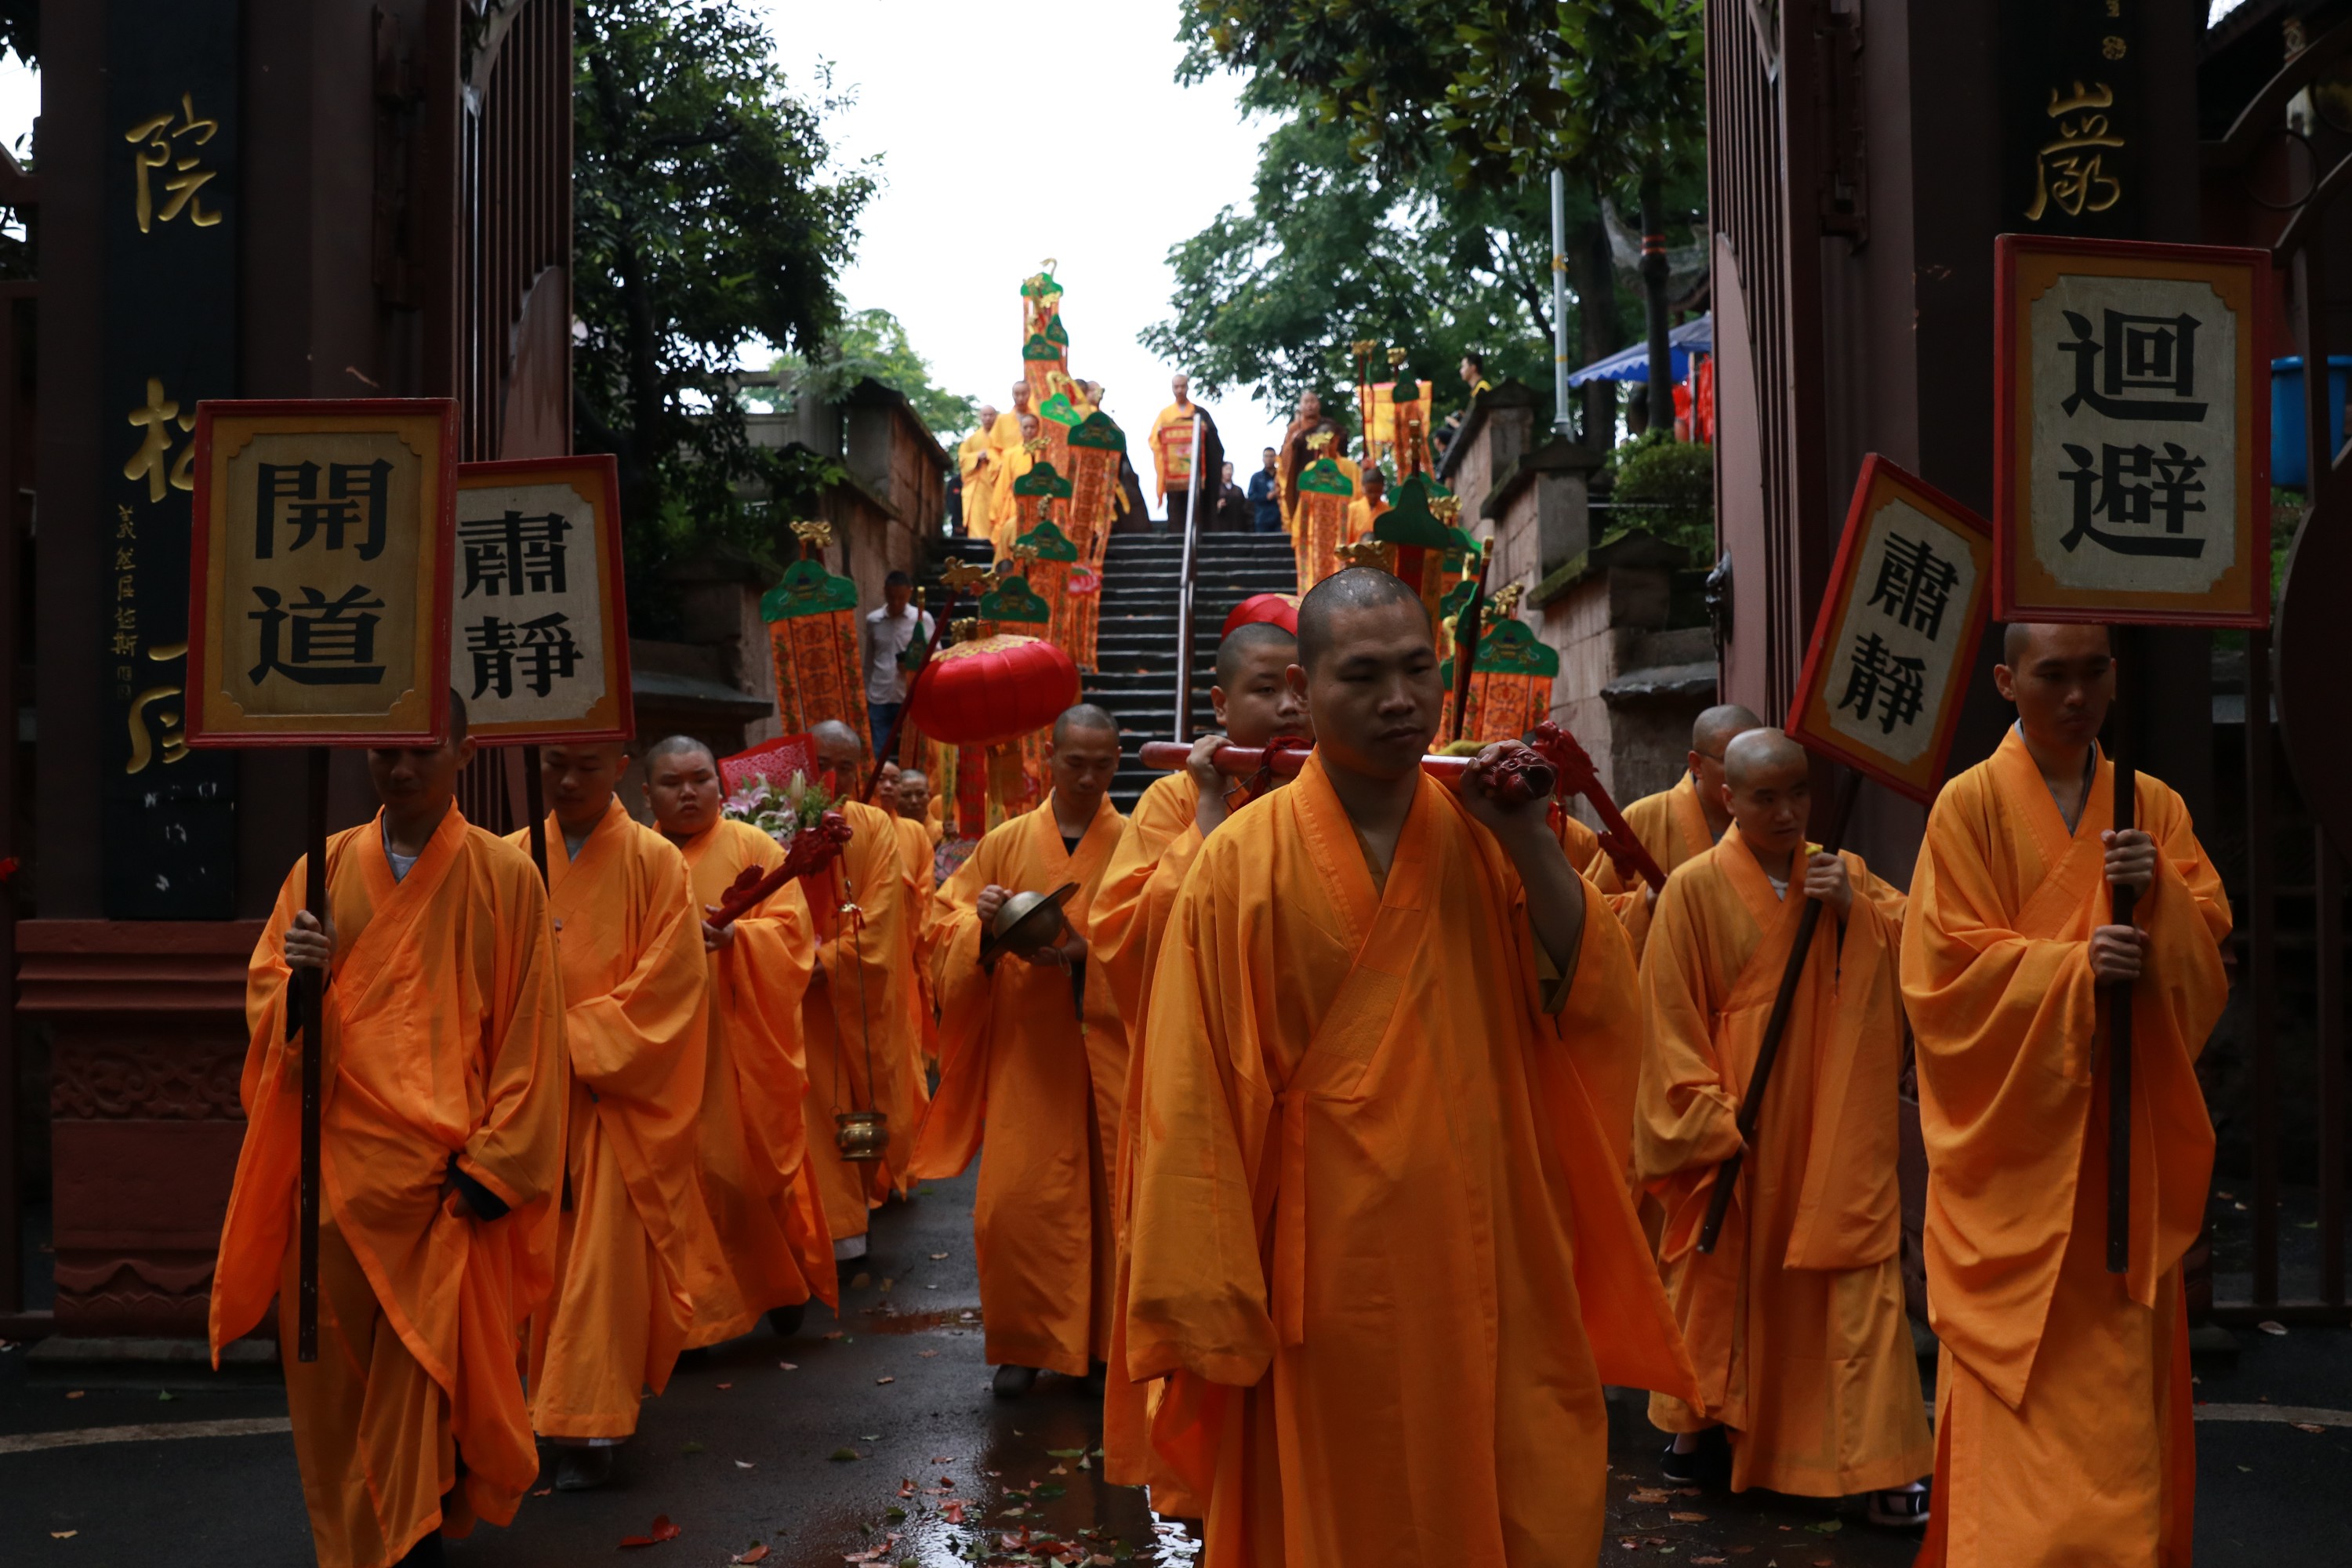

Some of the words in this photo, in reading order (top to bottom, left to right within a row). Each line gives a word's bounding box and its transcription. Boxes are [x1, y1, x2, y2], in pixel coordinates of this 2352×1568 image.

[2058, 309, 2209, 558] 迴避
[248, 459, 394, 686] 開道
[458, 510, 583, 700] 肅靜
[1838, 532, 1962, 735] 肅靜
